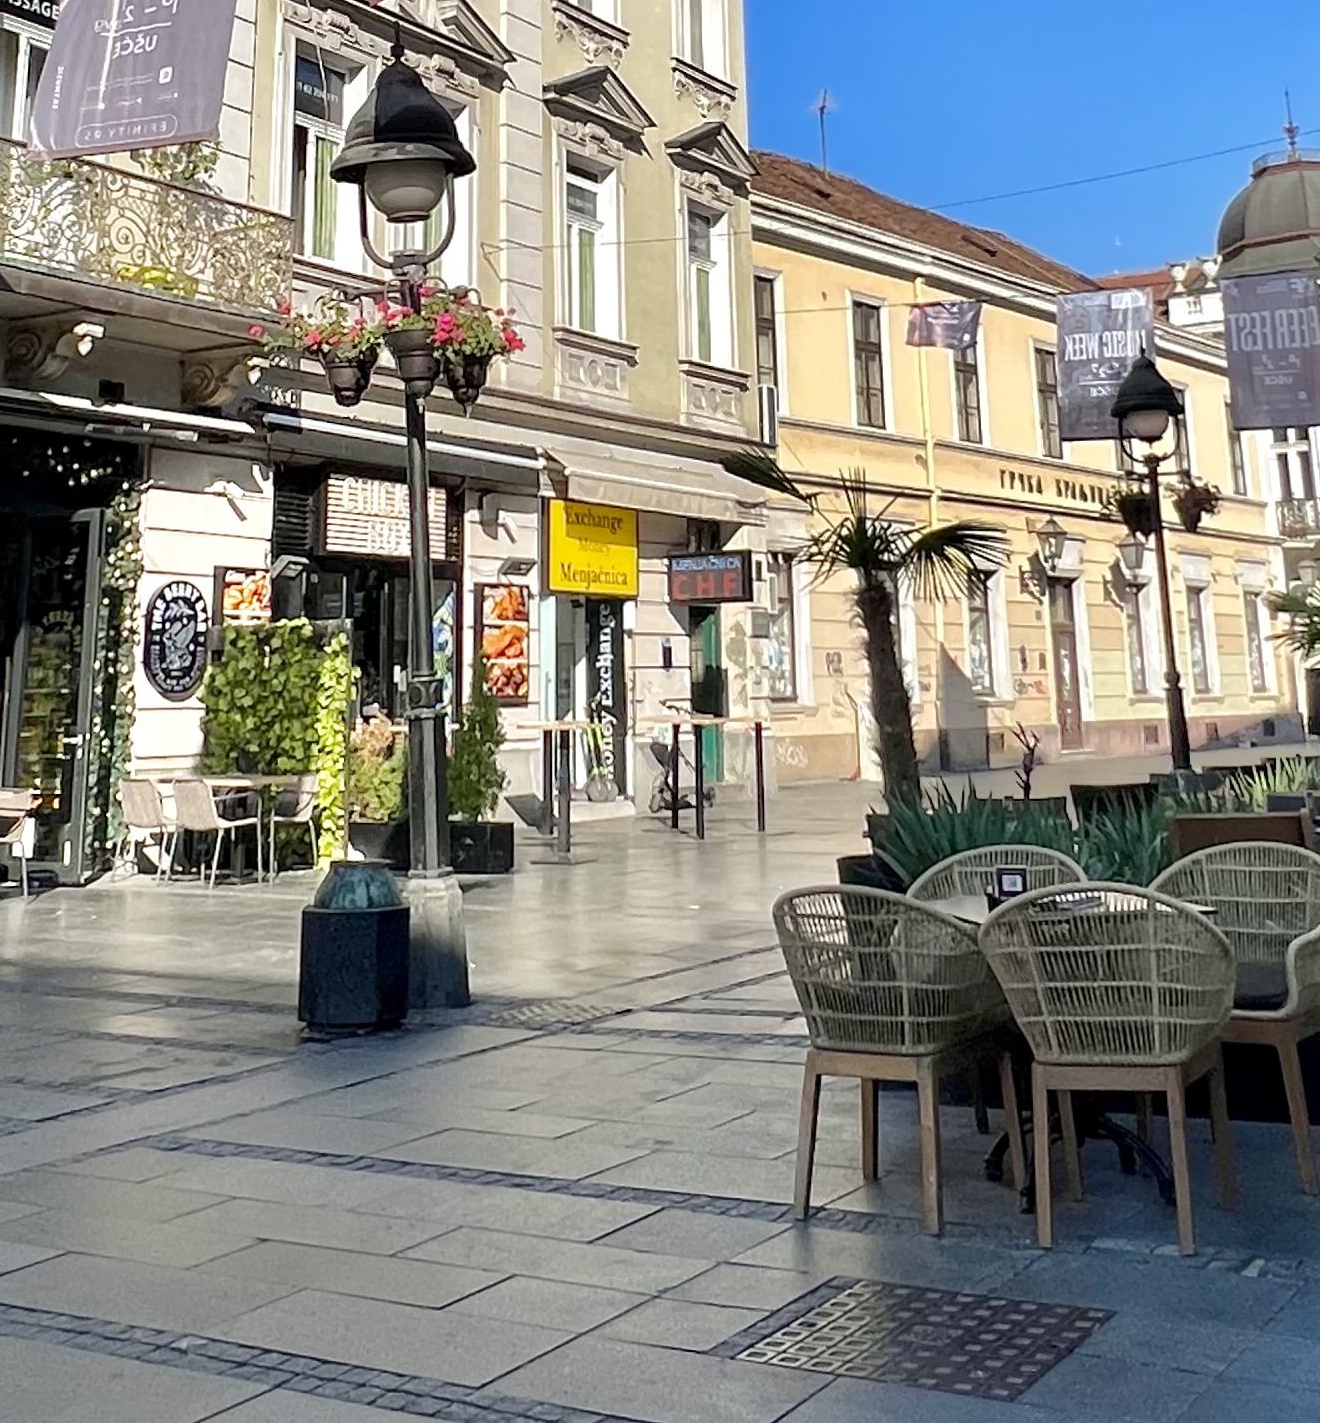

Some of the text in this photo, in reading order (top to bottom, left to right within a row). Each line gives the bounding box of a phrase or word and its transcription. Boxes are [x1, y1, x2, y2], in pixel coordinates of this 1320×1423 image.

[564, 505, 623, 534] Exchange
[579, 537, 611, 556] Money
[560, 561, 628, 590] Menjačnica
[671, 572, 737, 601] CHF
[601, 710, 619, 780] oney
